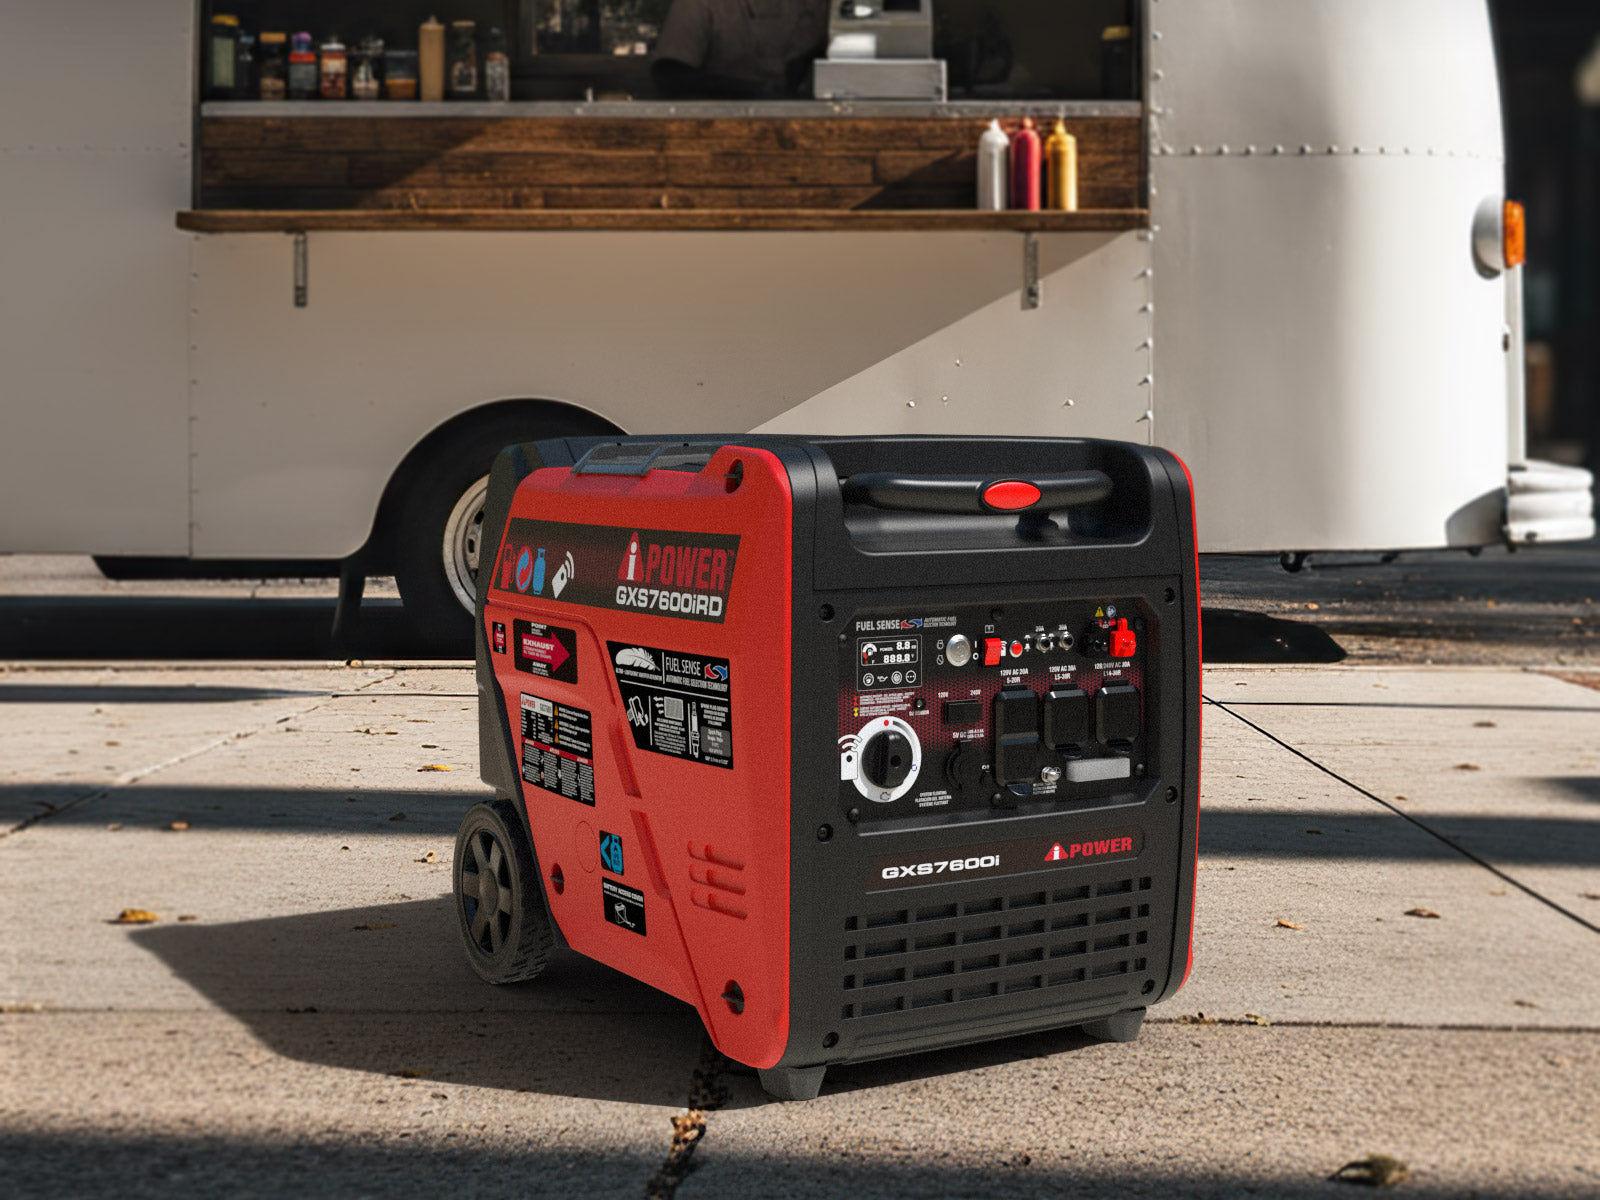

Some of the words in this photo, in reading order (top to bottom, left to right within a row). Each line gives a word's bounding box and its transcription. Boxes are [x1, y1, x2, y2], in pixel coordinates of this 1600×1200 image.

[615, 586, 723, 617] GXS7600iRD
[856, 621, 876, 631] FUEL
[876, 620, 901, 630] SENSE
[522, 638, 554, 651] EXHAUST
[665, 657, 681, 673] FUEL
[681, 659, 702, 676] SENSE
[883, 653, 911, 664] 888.8
[881, 854, 1000, 880] GXS7600i
